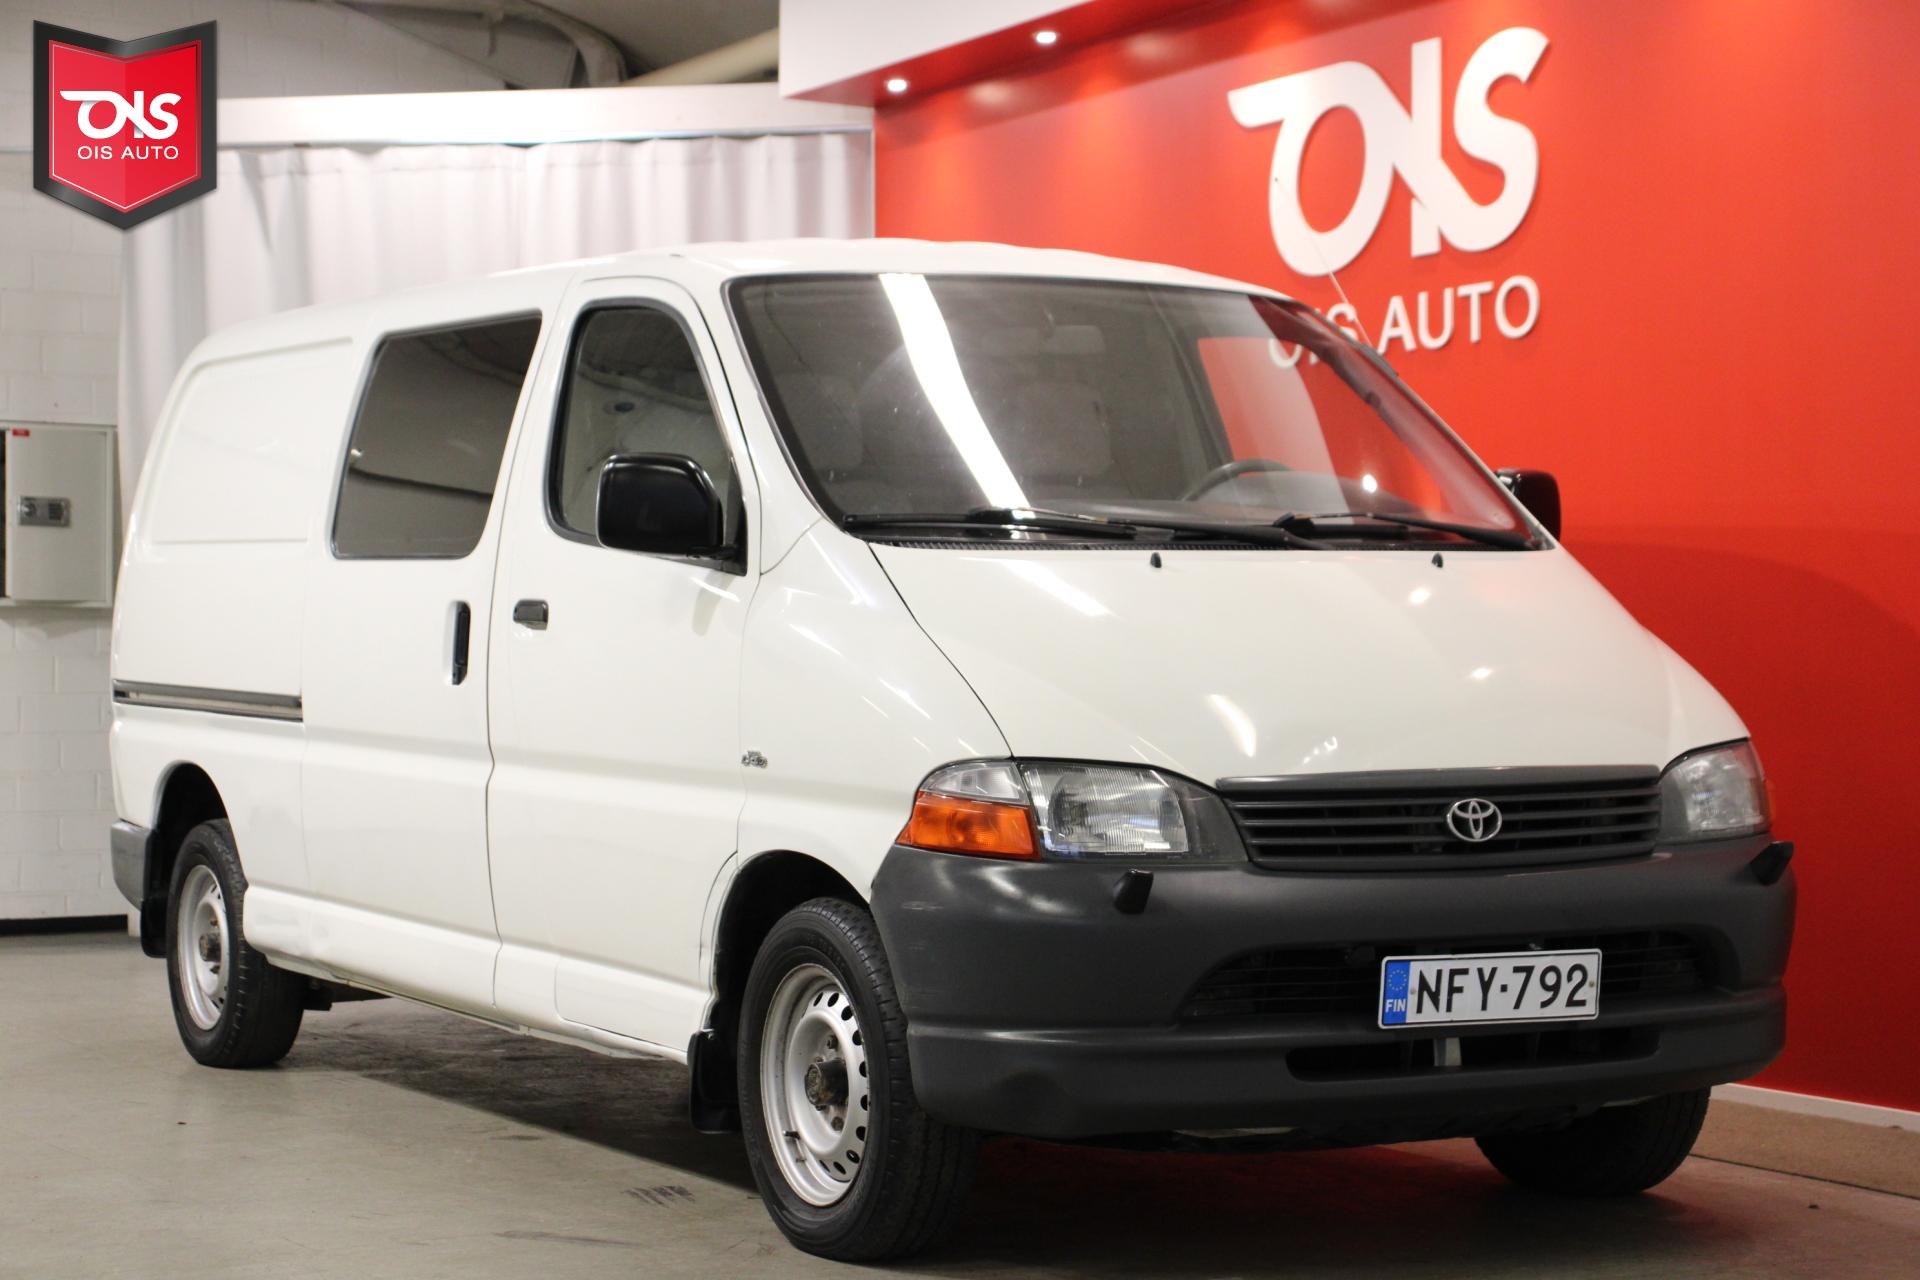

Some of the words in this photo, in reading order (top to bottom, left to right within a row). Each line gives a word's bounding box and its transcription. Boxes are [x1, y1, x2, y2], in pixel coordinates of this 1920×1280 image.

[1376, 275, 1540, 356] AUTO
[1385, 998, 1406, 1013] FIN
[1416, 963, 1588, 1014] NFY-792
